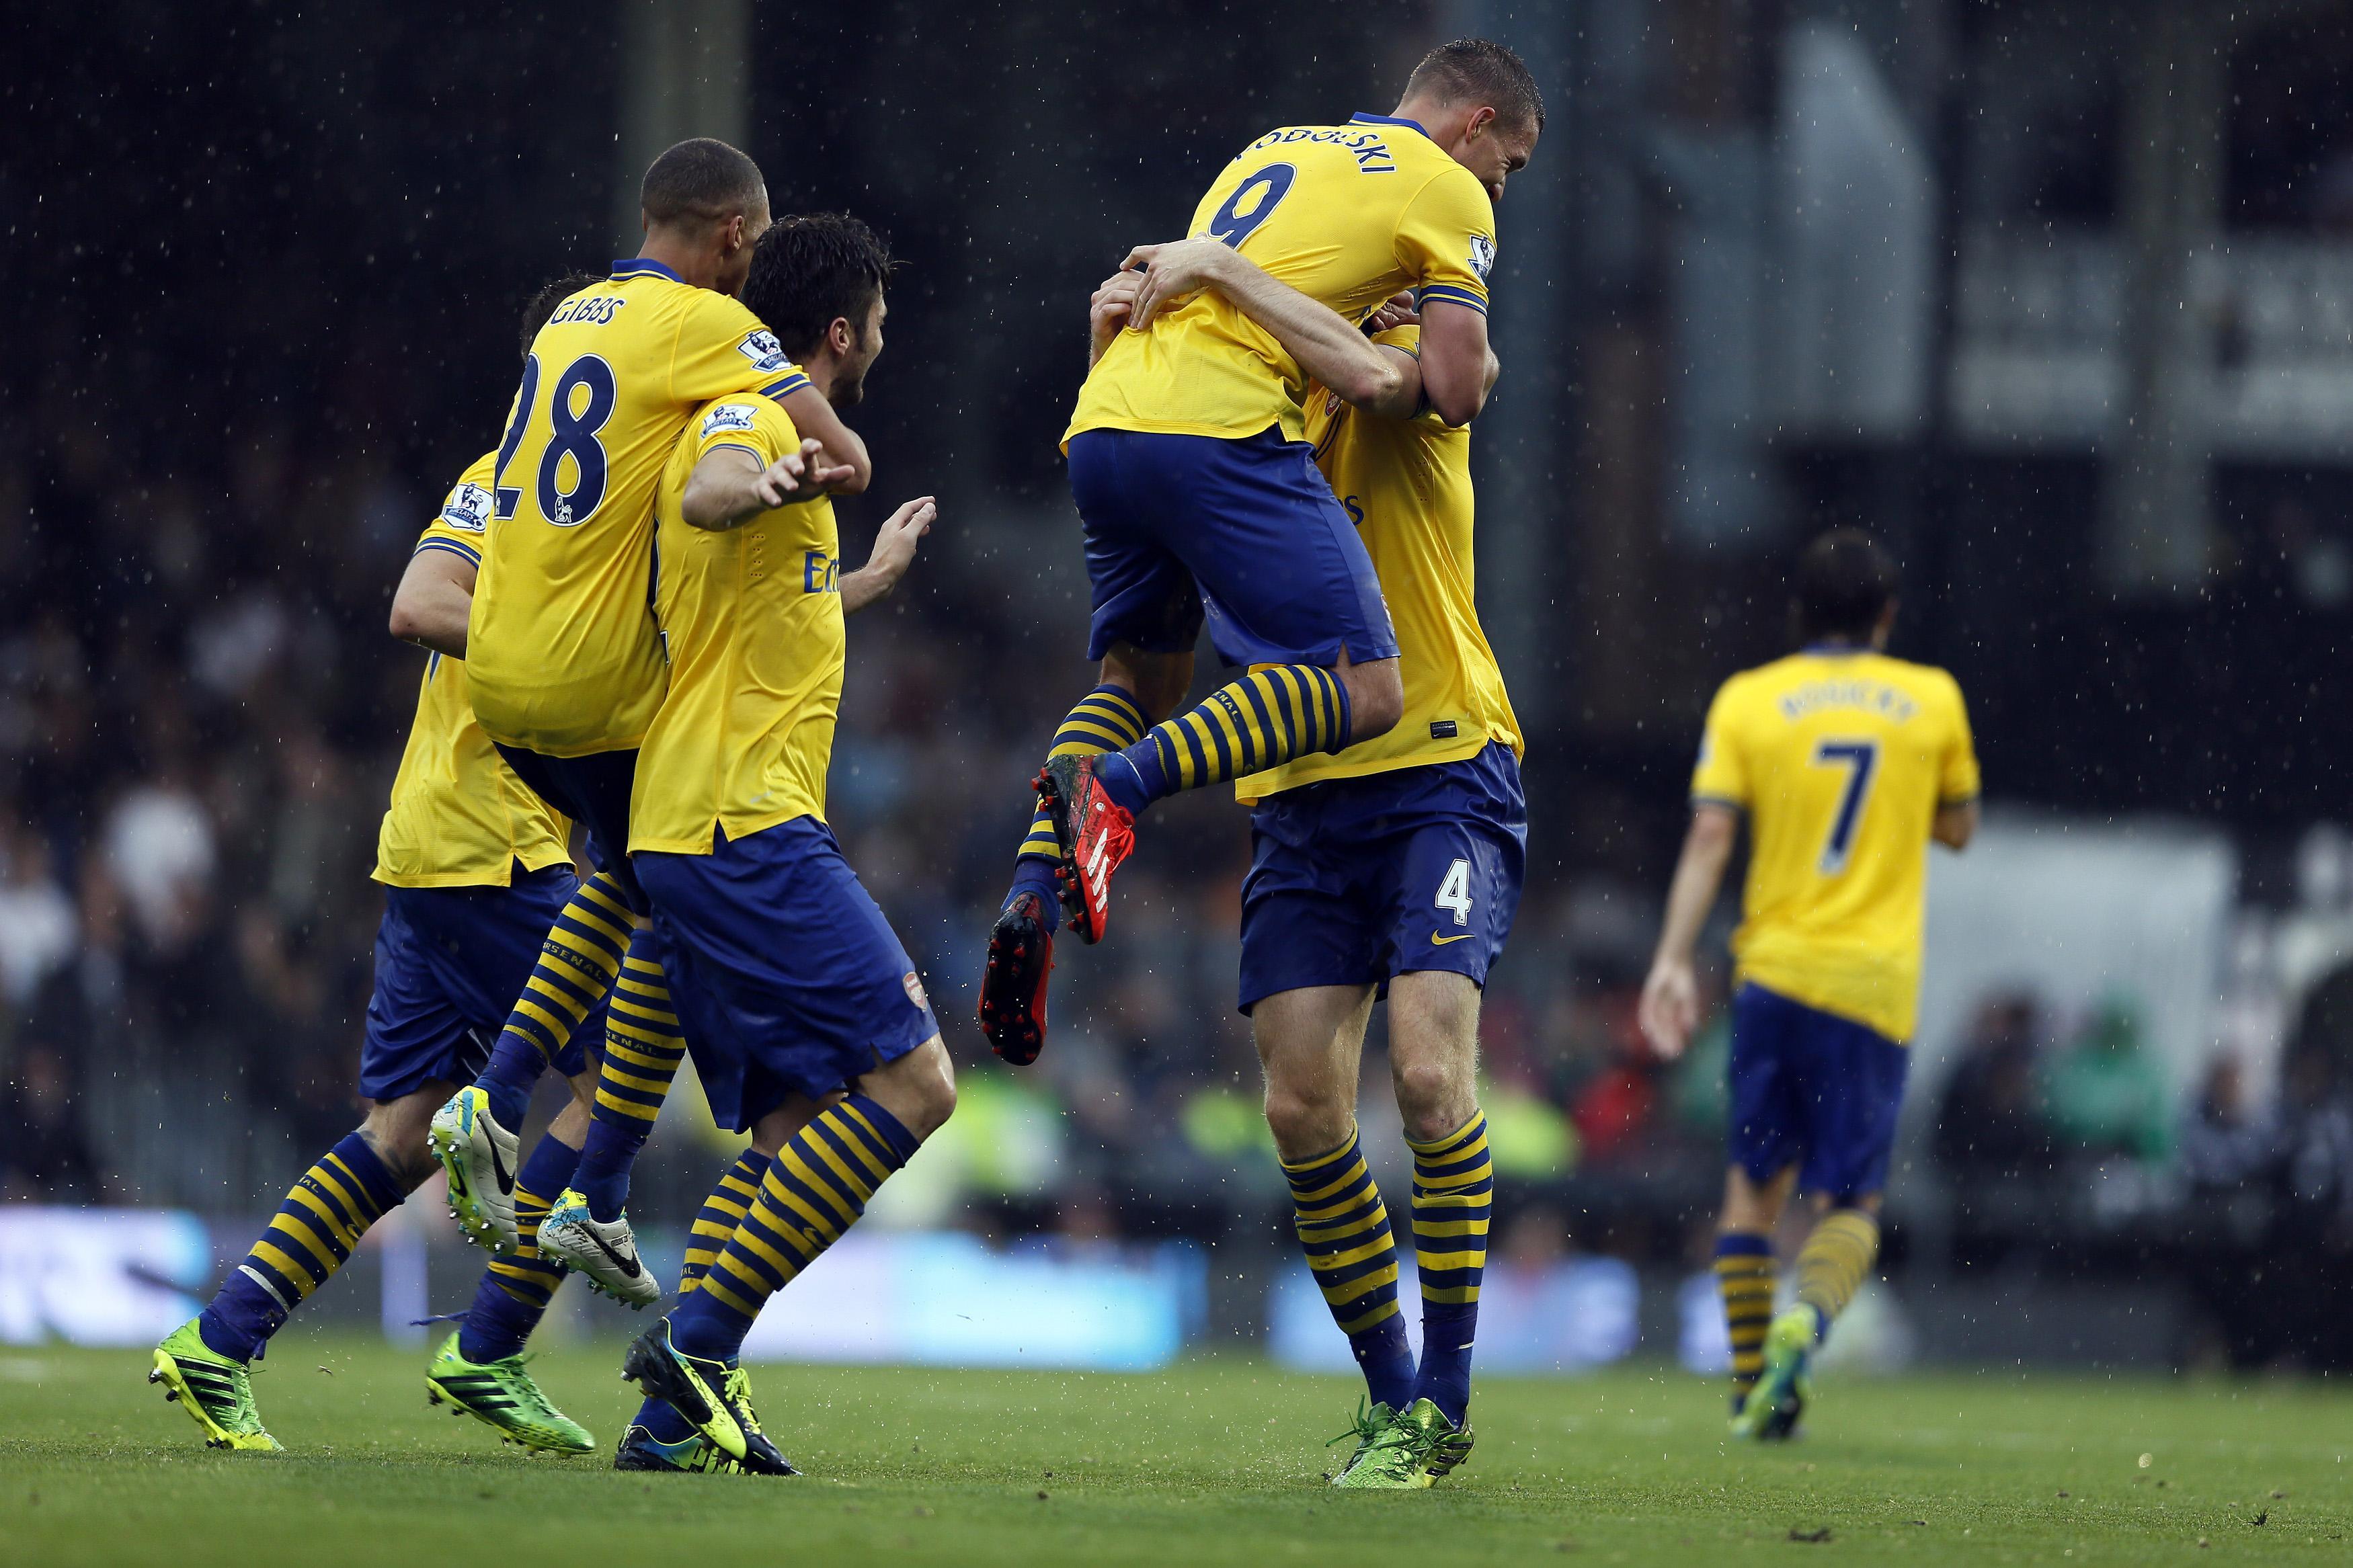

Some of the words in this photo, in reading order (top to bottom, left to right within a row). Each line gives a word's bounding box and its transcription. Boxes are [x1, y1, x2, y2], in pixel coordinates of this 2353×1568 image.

[1235, 129, 1396, 173] ODOLSKI
[1208, 162, 1297, 250] 9
[550, 296, 626, 325] GIBBS
[493, 352, 617, 527] 28
[1810, 738, 1881, 876] 7
[1435, 858, 1473, 926] 4
